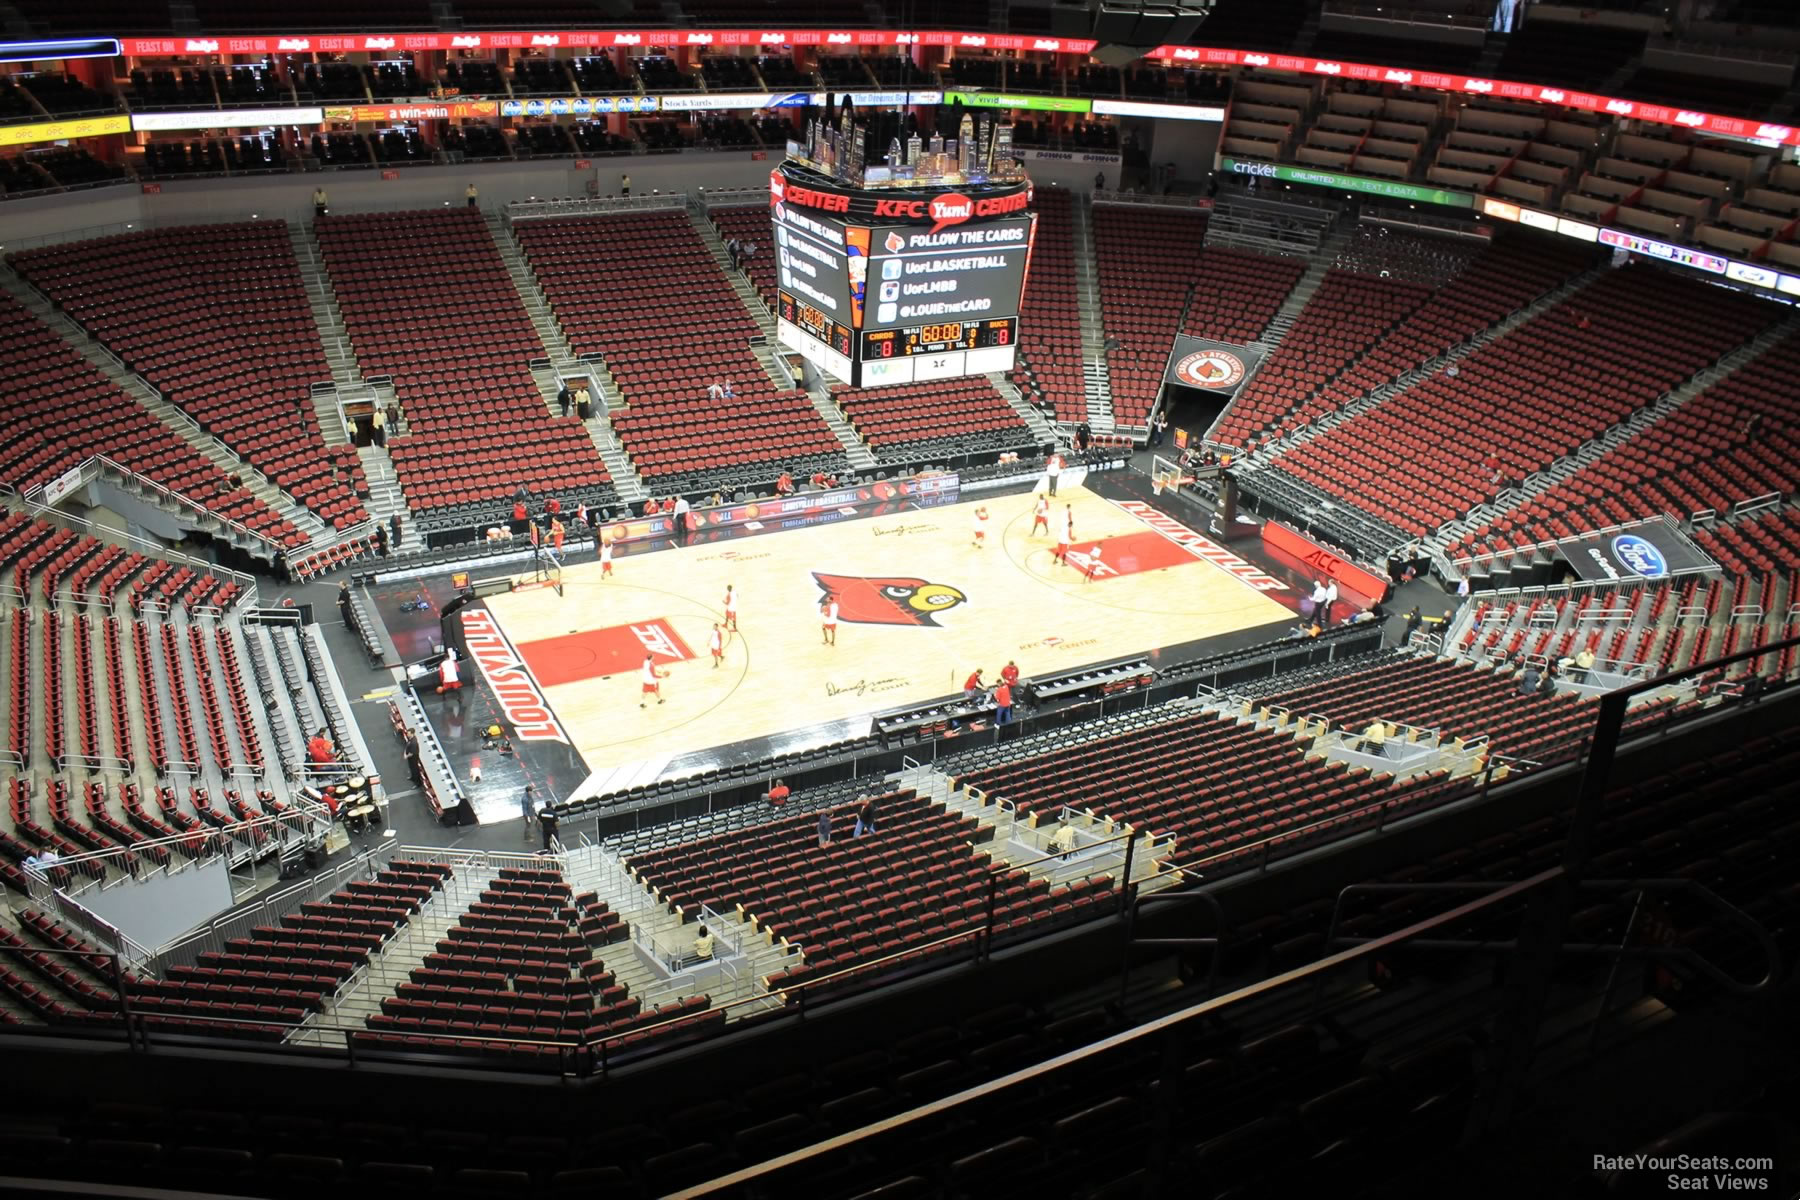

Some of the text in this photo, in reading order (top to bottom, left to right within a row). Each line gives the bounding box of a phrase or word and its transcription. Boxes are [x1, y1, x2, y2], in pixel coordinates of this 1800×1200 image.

[664, 99, 687, 107] Stock
[689, 99, 712, 107] Yards
[855, 94, 867, 103] The
[868, 94, 894, 102] Dreams
[390, 109, 397, 119] a
[400, 106, 448, 118] win-win
[1233, 161, 1277, 178] cricket
[1291, 171, 1335, 184] UNLIMITED
[1393, 185, 1418, 197] DATA
[786, 185, 850, 212] CENTER
[873, 191, 1028, 219] KFC Yum! CENTER
[909, 228, 1024, 248] FOLLOW THE CARDS
[922, 323, 961, 342] 60:00
[989, 320, 1009, 329] BUCS
[868, 331, 895, 341] CARDS
[928, 343, 945, 351] PERIOD
[781, 493, 857, 512] LOUISVILLE BASKETBALL
[1107, 498, 1290, 590] LOUISVILLE
[1304, 550, 1342, 574] ACC
[1618, 543, 1659, 572] Ford
[629, 624, 685, 660] ACC
[461, 608, 571, 745] LOUISVILLE
